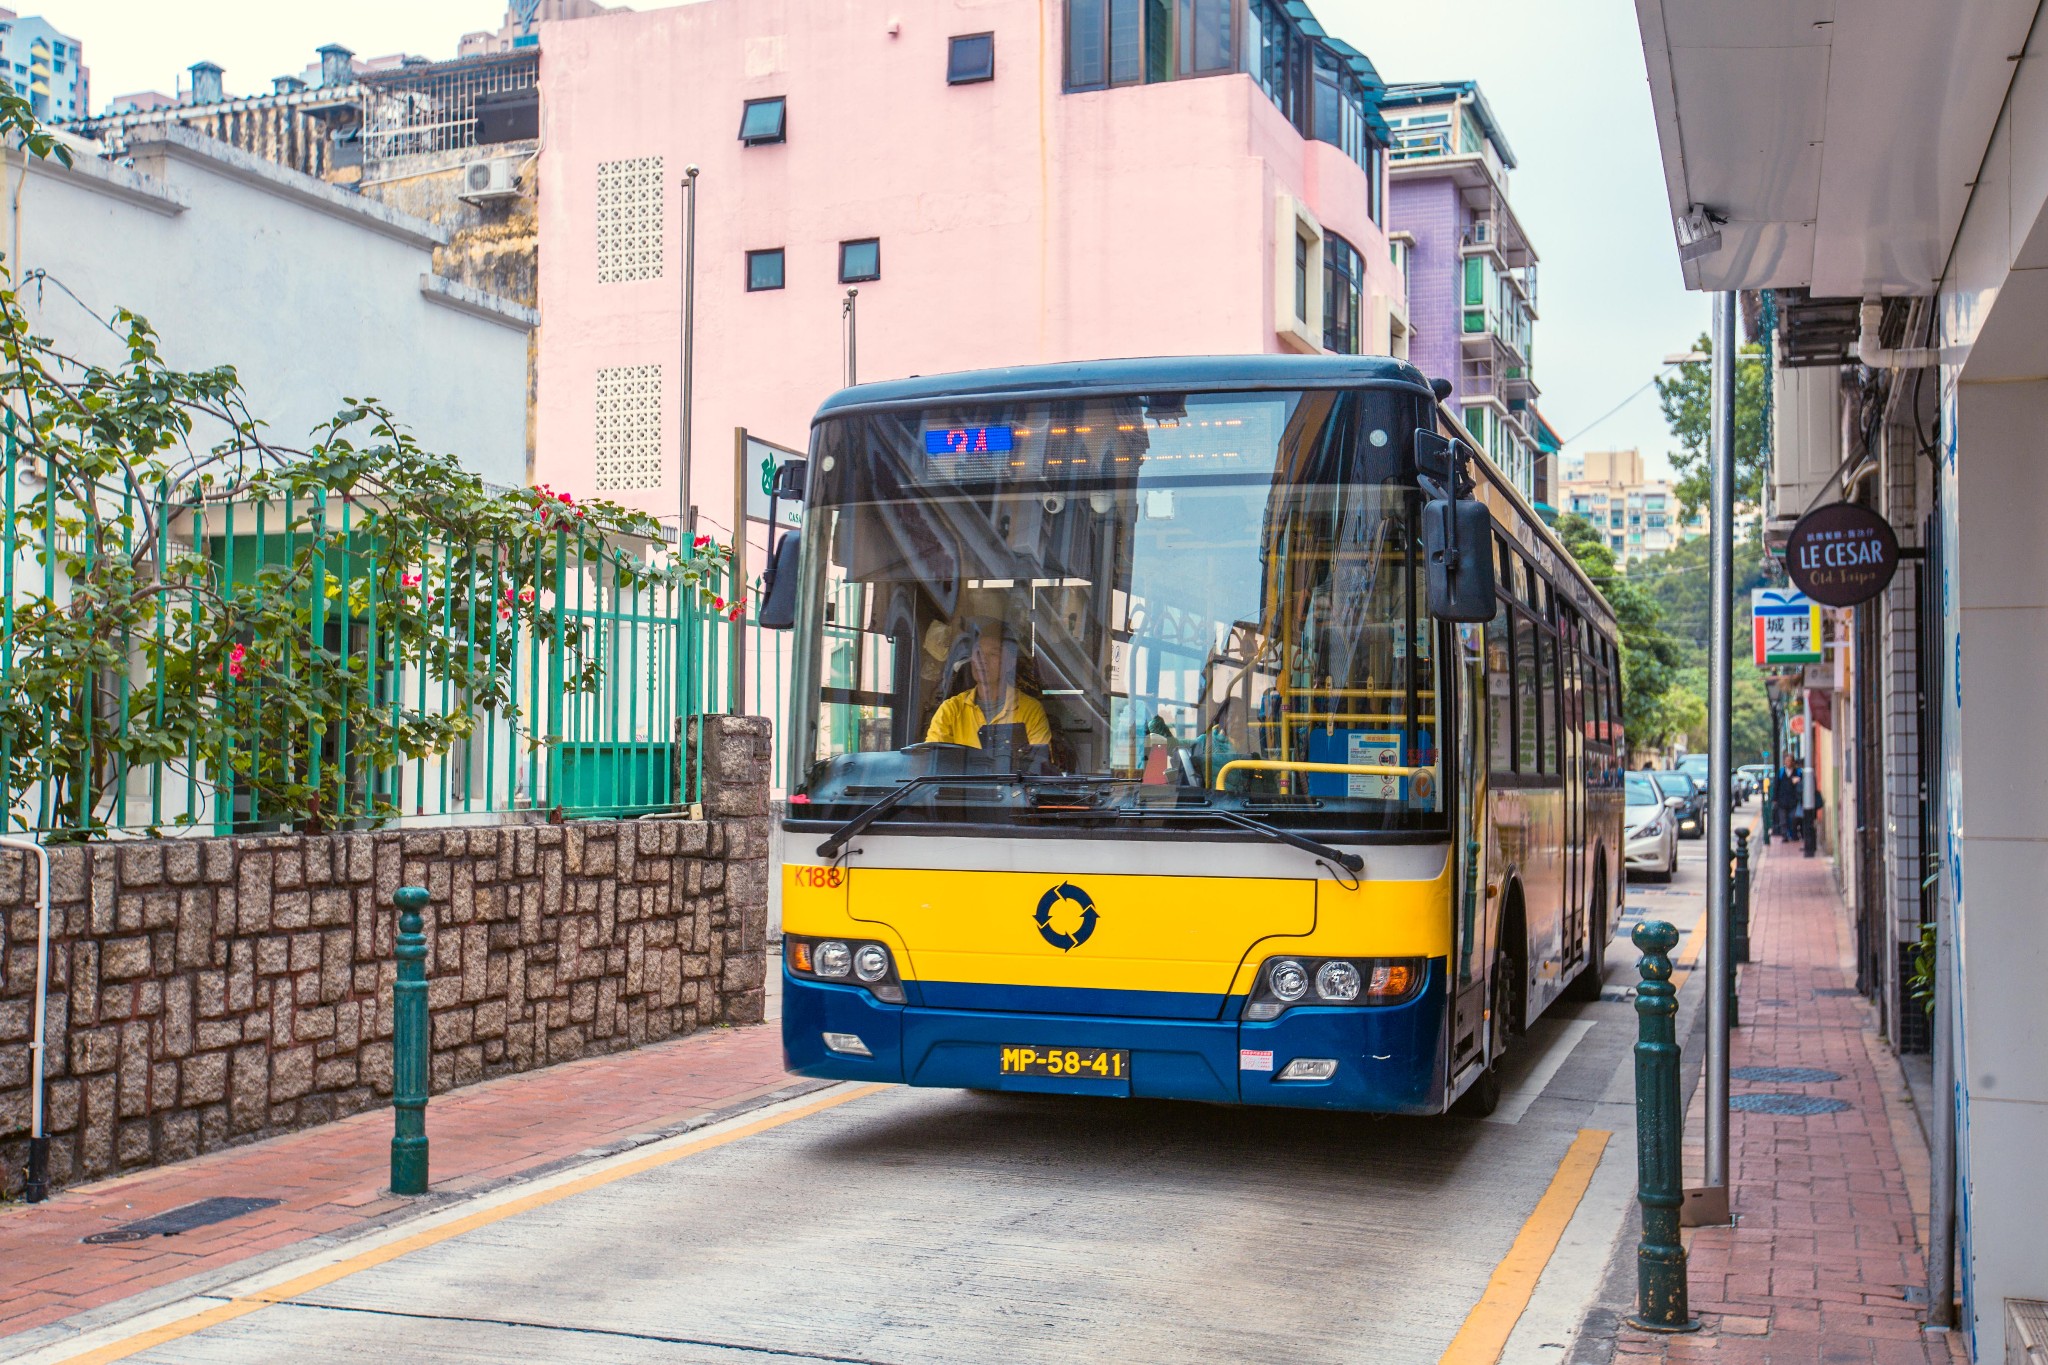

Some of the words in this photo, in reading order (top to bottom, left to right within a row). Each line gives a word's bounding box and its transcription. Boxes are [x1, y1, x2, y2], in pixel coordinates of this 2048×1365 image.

[1800, 545, 1821, 570] LE
[1824, 540, 1884, 567] CESAR
[1810, 570, 1833, 586] Old
[1839, 569, 1876, 585] Taipa
[795, 866, 841, 888] K188
[1003, 1048, 1121, 1077] MP-58-41
